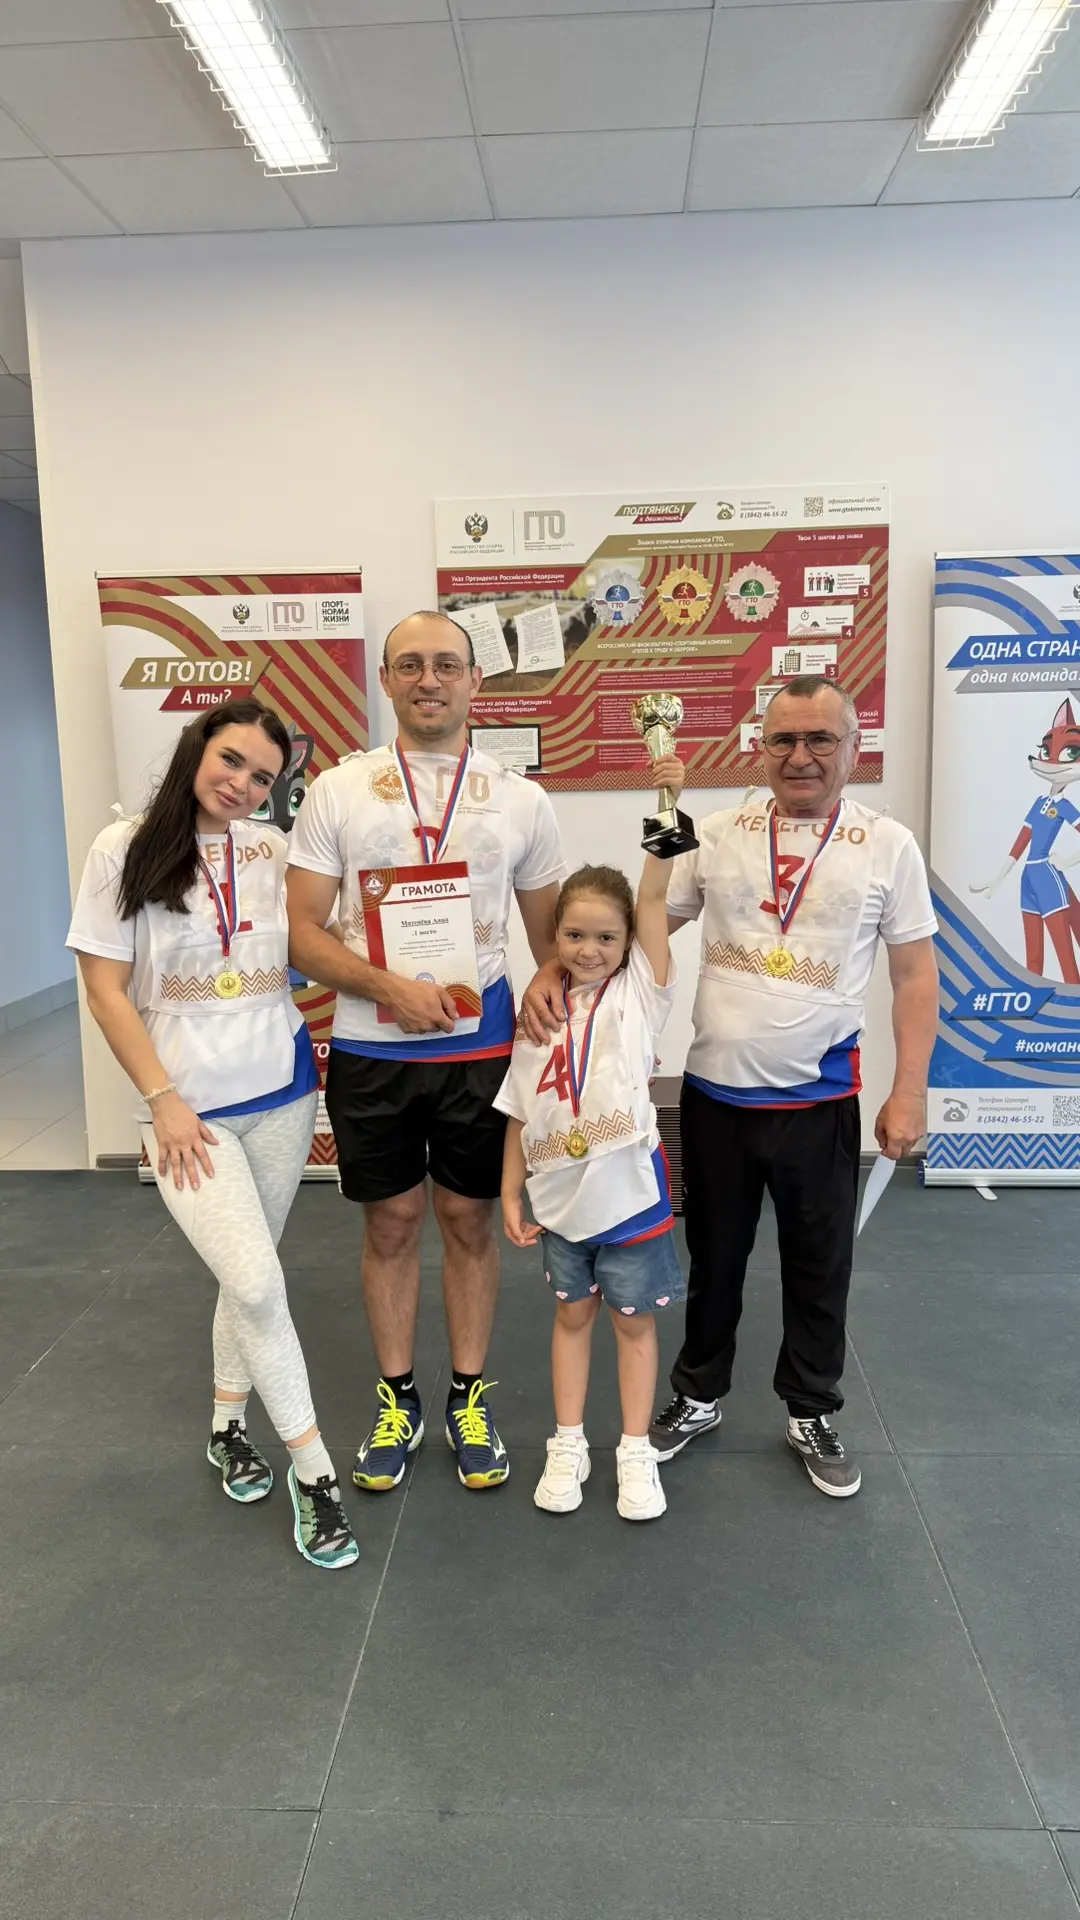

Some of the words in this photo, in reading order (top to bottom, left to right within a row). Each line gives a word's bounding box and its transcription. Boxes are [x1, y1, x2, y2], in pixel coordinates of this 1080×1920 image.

[623, 505, 685, 519] ПОДТЯНИСЬ!
[524, 510, 565, 540] ГТО
[499, 573, 531, 581] Российской
[863, 588, 869, 597] 5
[272, 601, 305, 624] ГТО
[322, 615, 350, 623] ЖИЗНИ
[845, 628, 852, 637] 4
[969, 642, 1022, 661] ОДНА
[140, 661, 157, 682] Я
[165, 660, 252, 683] ГОТОВ!
[830, 667, 835, 676] 3
[970, 669, 1007, 684] одна
[181, 690, 193, 704] А
[196, 689, 232, 706] ты?
[859, 710, 879, 718] УЗНАЙ
[401, 882, 457, 897] ГРАМОТА
[759, 855, 805, 915] 3
[973, 991, 1031, 1013] #ГТО
[536, 1043, 571, 1102] 4
[984, 1115, 1008, 1124] (3842)
[1010, 1115, 1045, 1123] 46-55-22
